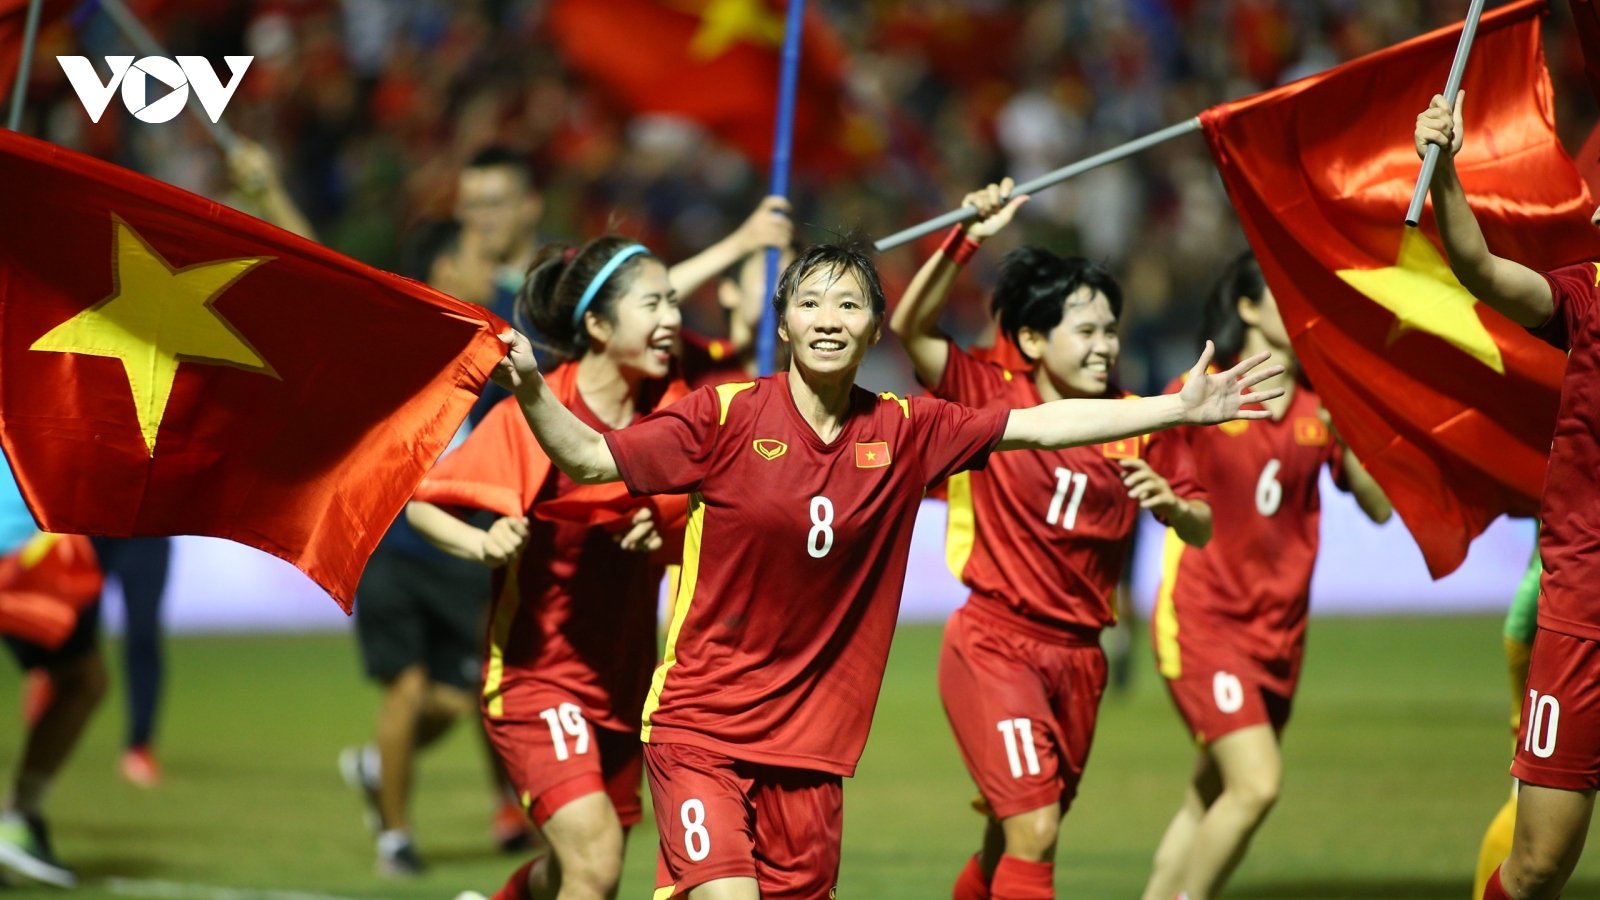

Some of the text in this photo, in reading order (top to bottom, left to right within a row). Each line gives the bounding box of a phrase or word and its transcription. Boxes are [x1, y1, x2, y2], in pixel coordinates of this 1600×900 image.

[1046, 466, 1088, 531] 11
[1255, 459, 1282, 516] 6
[807, 495, 835, 559] 8
[1212, 670, 1244, 714] 6
[1524, 688, 1560, 758] 10
[539, 701, 591, 763] 19
[996, 717, 1042, 779] 11
[680, 797, 711, 862] 8
